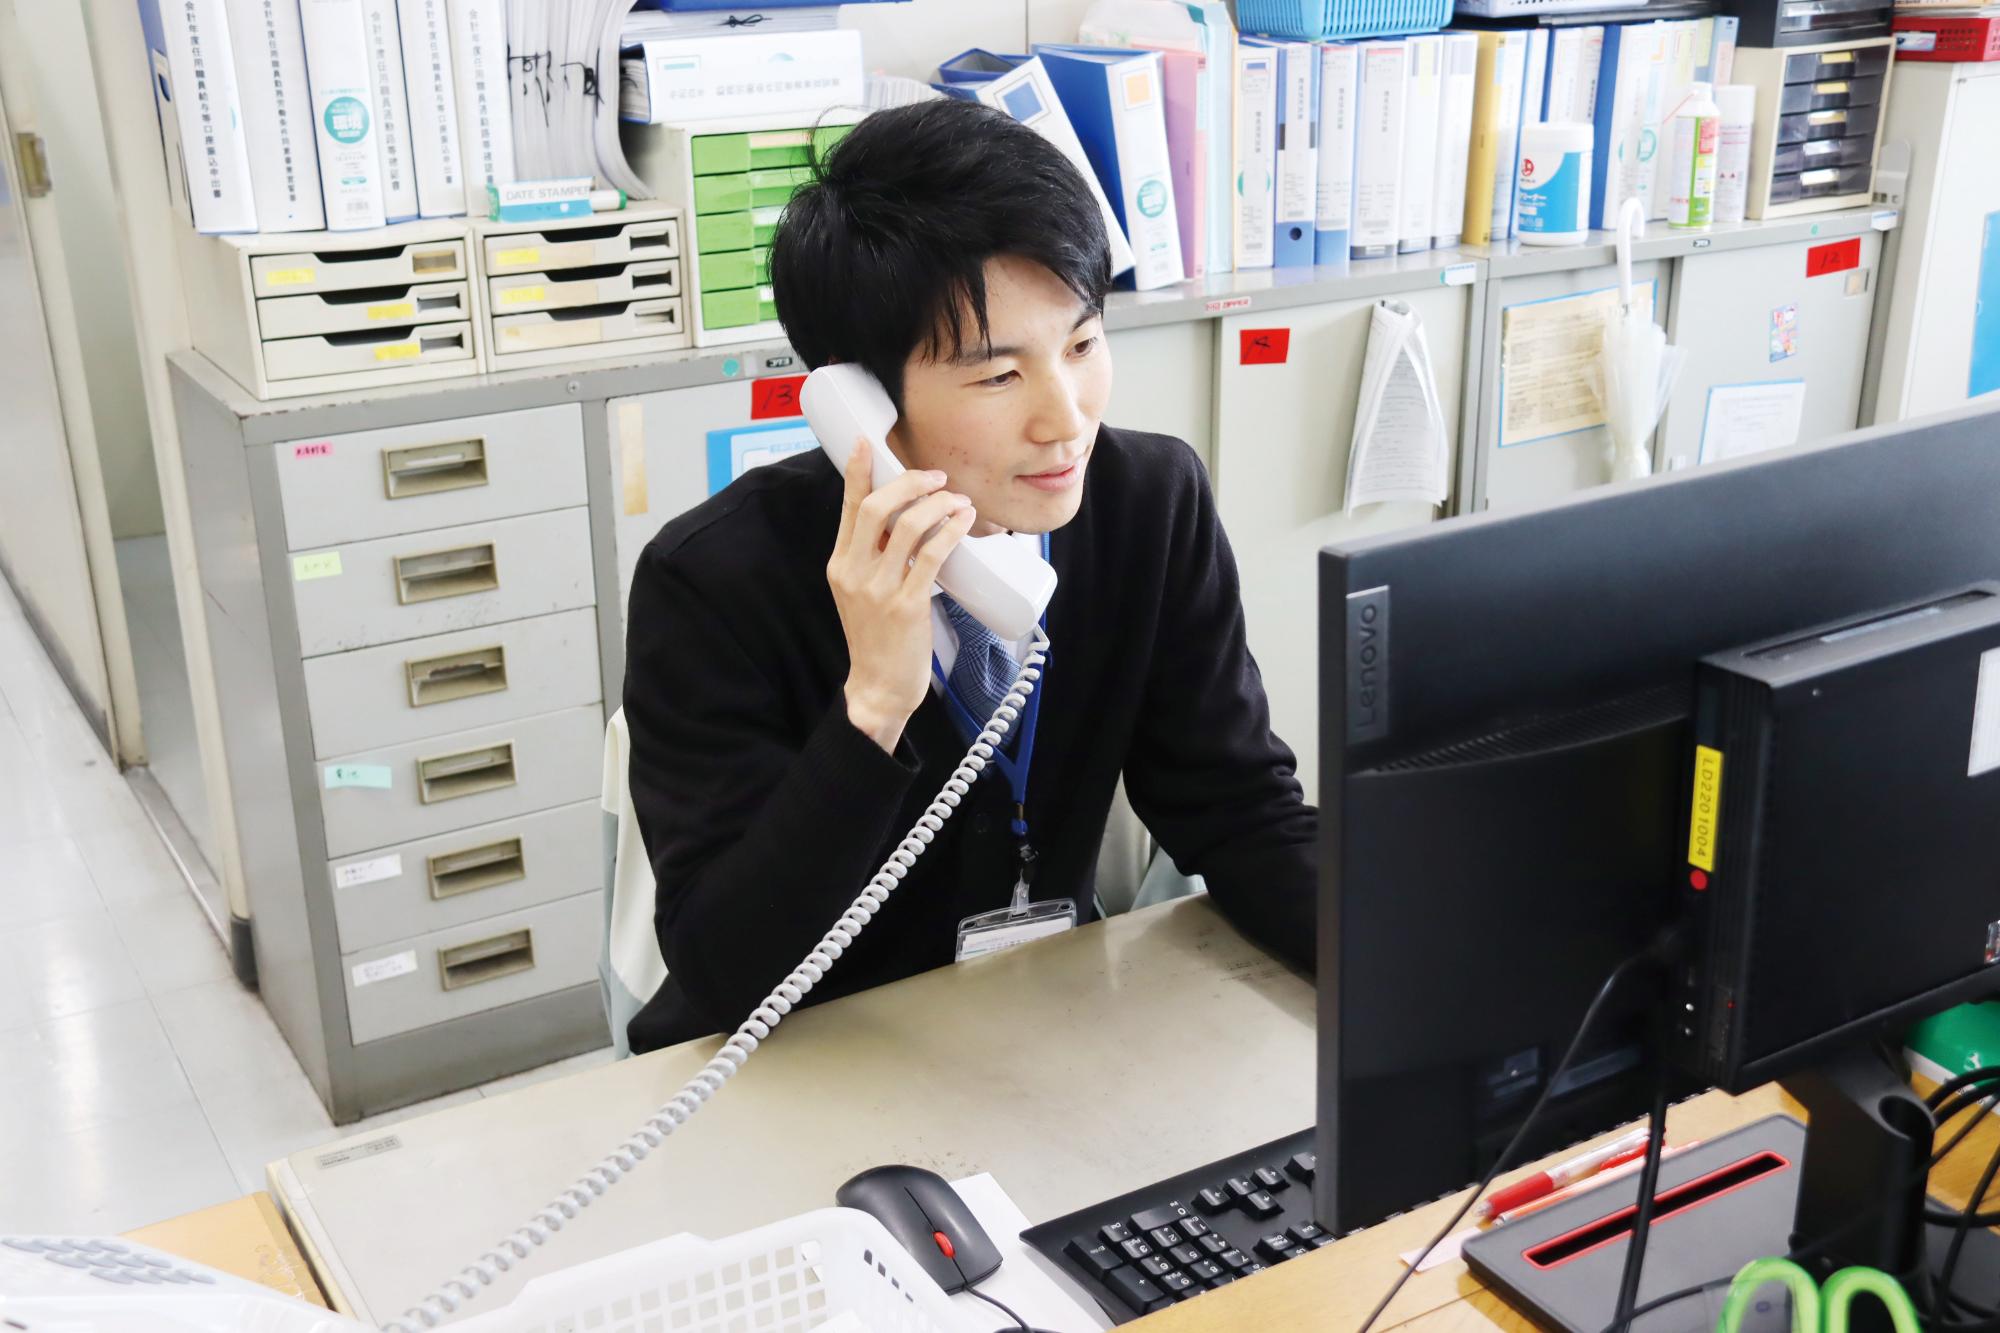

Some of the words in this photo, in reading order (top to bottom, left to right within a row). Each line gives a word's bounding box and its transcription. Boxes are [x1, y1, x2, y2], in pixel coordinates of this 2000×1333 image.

[506, 188, 536, 201] DATE
[762, 384, 793, 411] 13
[1356, 603, 1377, 728] Lenovo
[1177, 1207, 1186, 1215] 0
[1168, 1233, 1177, 1242] 2
[1139, 1244, 1148, 1253] 3
[1188, 1250, 1198, 1259] 5
[1159, 1262, 1169, 1270] 6
[1209, 1265, 1218, 1273] 8
[1180, 1277, 1190, 1285] 9
